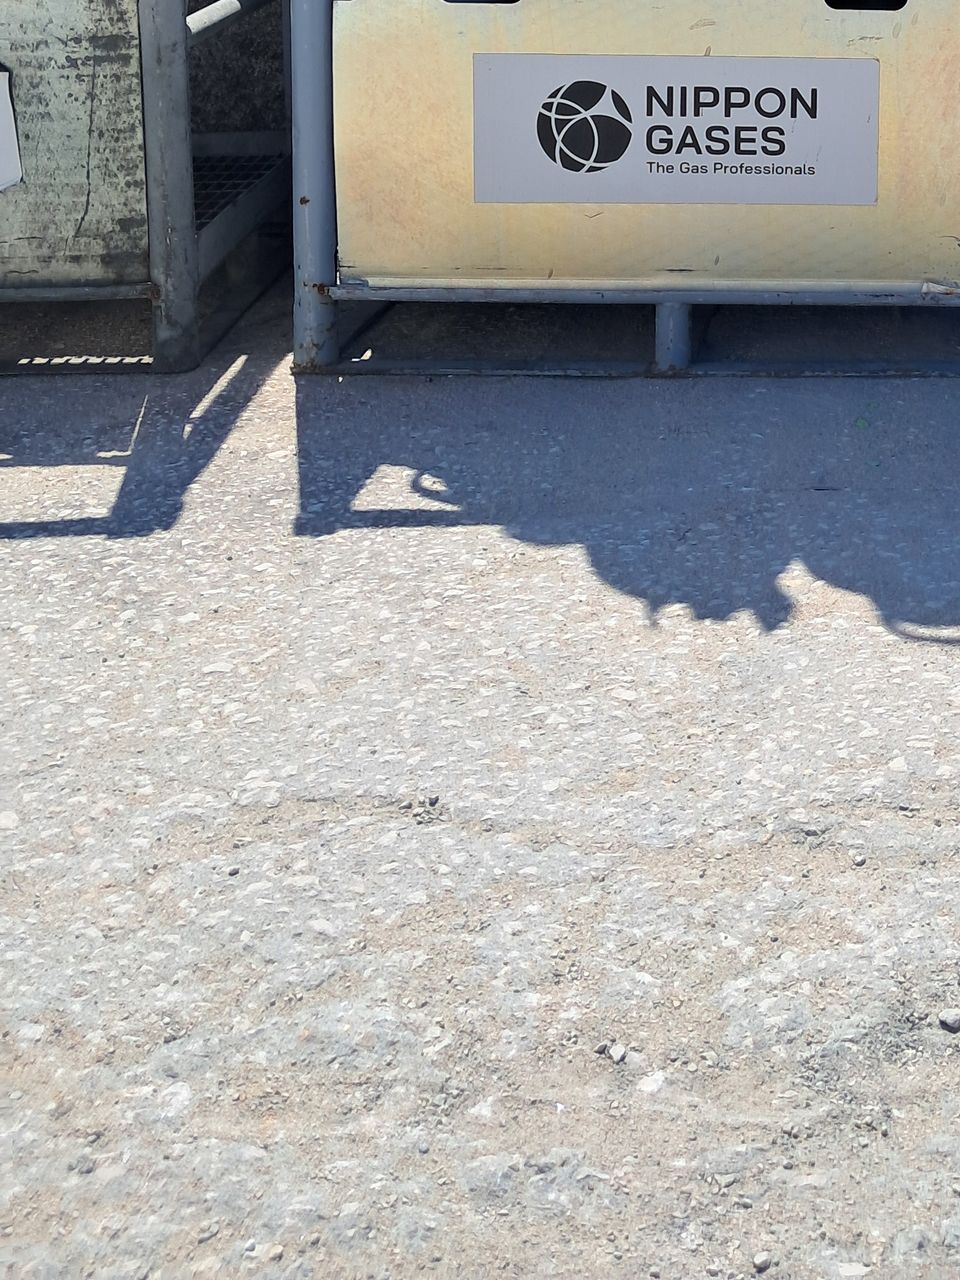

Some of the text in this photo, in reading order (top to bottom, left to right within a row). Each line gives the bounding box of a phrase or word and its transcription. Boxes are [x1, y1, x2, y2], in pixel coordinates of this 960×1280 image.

[646, 85, 818, 119] NIPPON
[645, 125, 786, 156] GASES
[646, 162, 816, 175] The Gas Professionals
